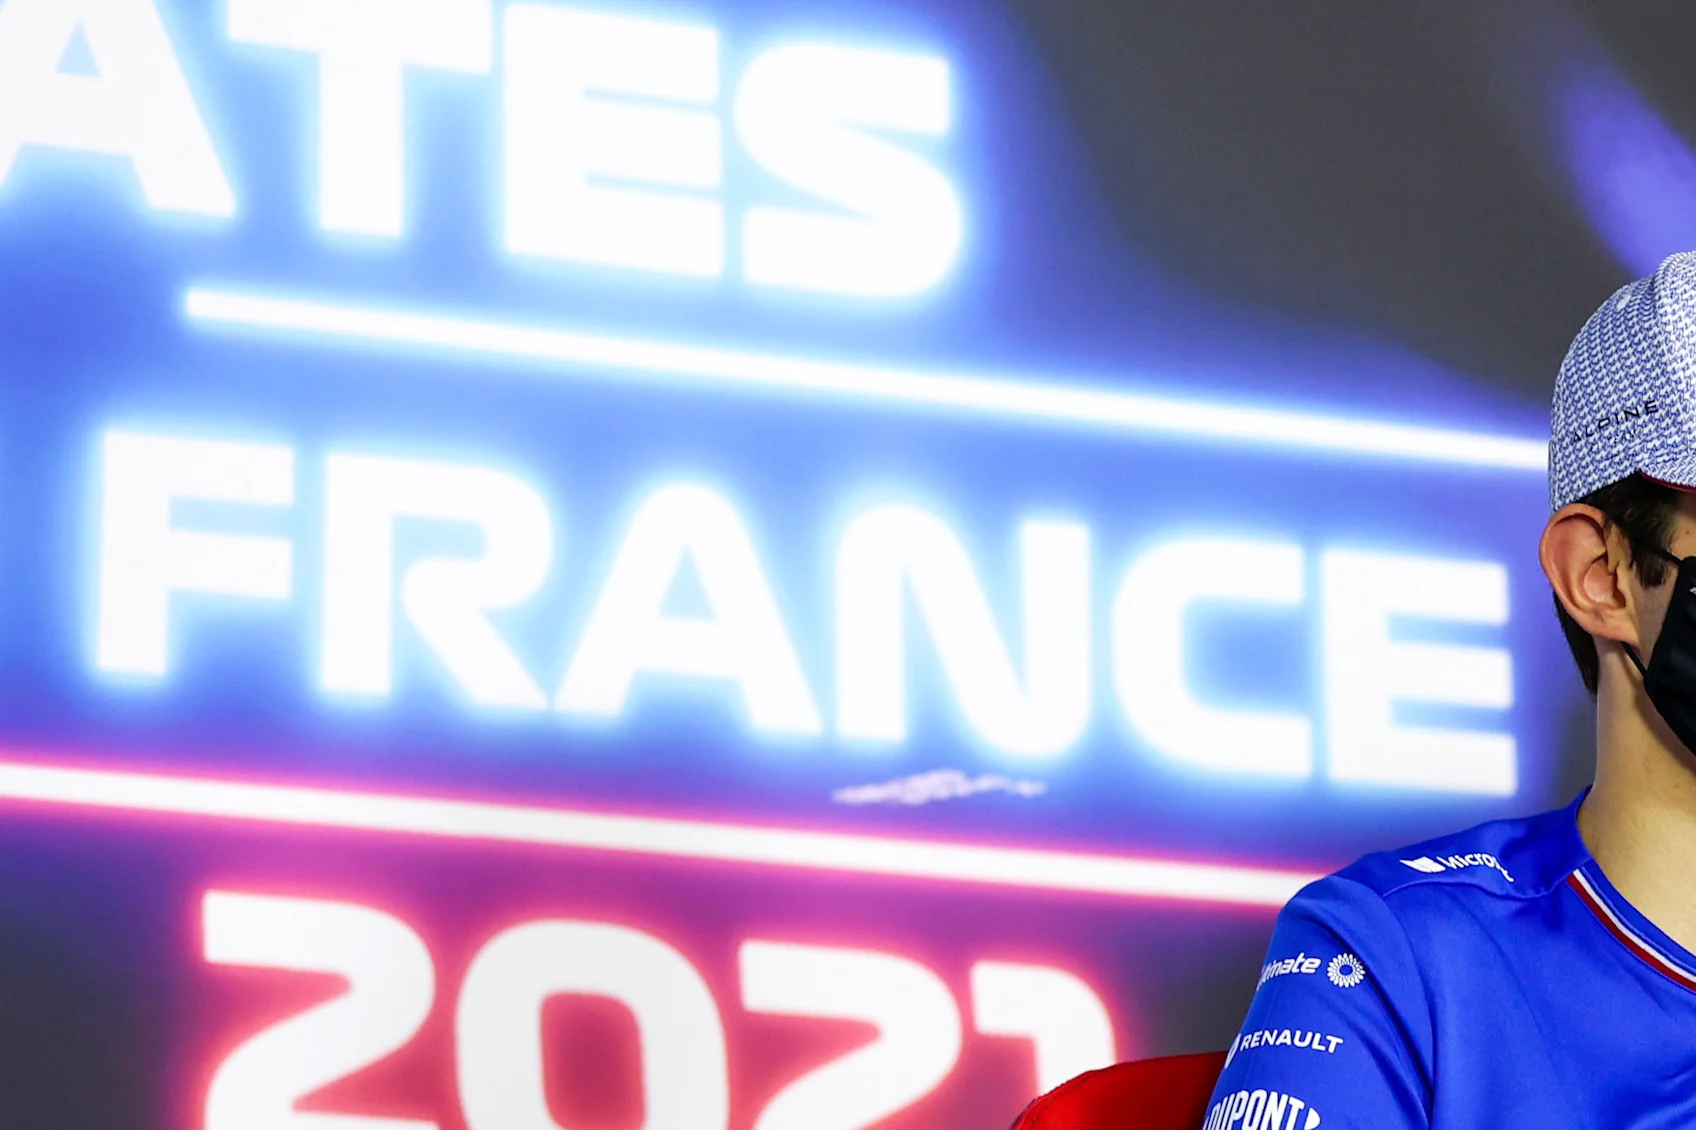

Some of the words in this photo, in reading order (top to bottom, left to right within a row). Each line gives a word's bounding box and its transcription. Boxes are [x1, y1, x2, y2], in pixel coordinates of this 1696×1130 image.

[1574, 400, 1659, 442] ALPINE
[96, 428, 1518, 797] FRANCE
[1240, 1029, 1344, 1054] RENAULT
